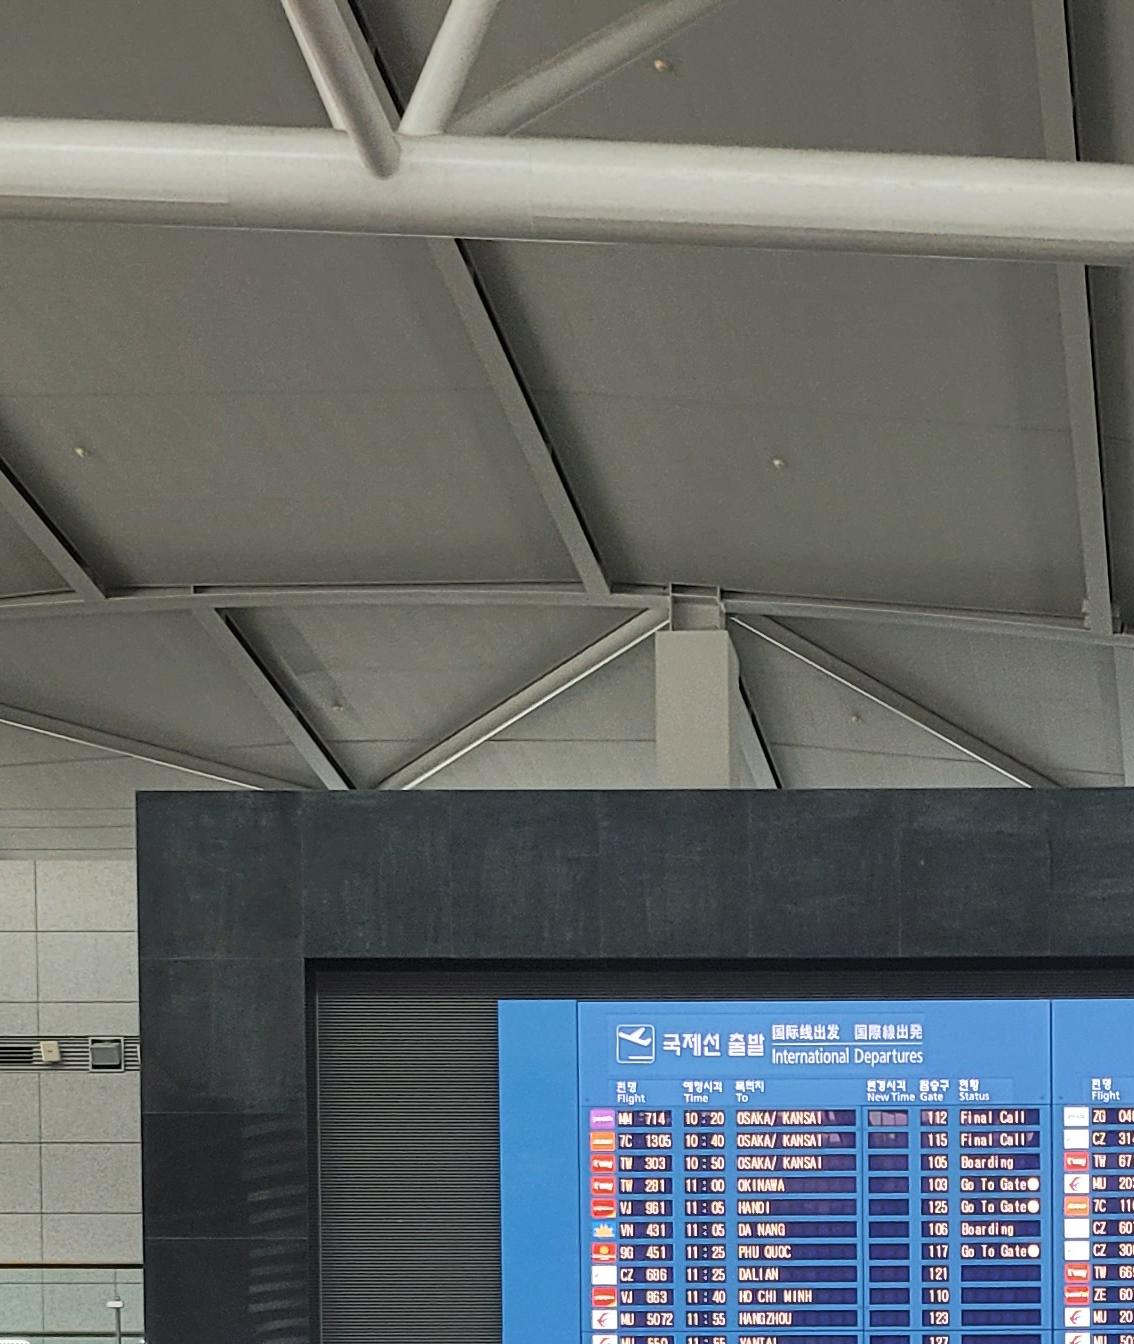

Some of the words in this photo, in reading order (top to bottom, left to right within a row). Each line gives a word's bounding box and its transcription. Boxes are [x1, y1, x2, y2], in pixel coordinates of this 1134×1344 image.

[770, 1023, 841, 1041] 国际线出发
[662, 1033, 722, 1058] 국제선
[726, 1033, 766, 1058] 출발
[771, 1047, 850, 1066] International
[853, 1047, 924, 1068] Departures
[616, 1092, 646, 1105] Flight
[683, 1092, 710, 1104] Time
[735, 1092, 750, 1104] To
[866, 1091, 890, 1103] New
[891, 1091, 917, 1103] Time
[919, 1091, 945, 1103] Gate
[958, 1091, 991, 1103] Status
[1091, 1089, 1121, 1103] Flight
[736, 1111, 777, 1126] OSAKA/
[781, 1111, 822, 1125] KANSAI
[927, 1110, 948, 1125] 112
[960, 1110, 993, 1125] Final
[999, 1110, 1025, 1124] Call
[736, 1133, 777, 1149] OSAKA/
[782, 1133, 822, 1147] KANSAI
[928, 1132, 948, 1147] 115
[960, 1133, 993, 1147] Final
[999, 1132, 1025, 1146] Call
[737, 1156, 777, 1171] OSAKA/
[782, 1156, 822, 1170] KANSAI
[928, 1155, 948, 1169] 105
[960, 1155, 1014, 1170] Boarding
[737, 1178, 785, 1192] OKINAWA
[928, 1177, 948, 1192] 103
[960, 1178, 975, 1191] Go
[980, 1177, 995, 1191] To
[999, 1177, 1027, 1191] Gate
[737, 1200, 770, 1215] HANOI
[929, 1200, 948, 1214] 125
[960, 1200, 975, 1214] Go
[981, 1199, 995, 1213] To
[999, 1199, 1027, 1213] Gate
[738, 1223, 752, 1237] DA
[756, 1223, 786, 1237] NANG
[929, 1222, 949, 1236] 106
[961, 1222, 1014, 1237] Boarding
[738, 1245, 760, 1259] PHU
[763, 1245, 792, 1259] QUOC
[929, 1244, 949, 1258] 117
[961, 1244, 975, 1258] Go
[981, 1244, 995, 1258] To
[1000, 1244, 1027, 1258] Gate
[738, 1267, 779, 1281] DALIAN
[929, 1267, 948, 1281] 121
[738, 1289, 753, 1303] HO
[757, 1289, 777, 1303] CHI
[783, 1289, 813, 1303] MINH
[929, 1289, 950, 1303] 110
[739, 1311, 792, 1325] HANGZHOU
[929, 1311, 949, 1325] 123
